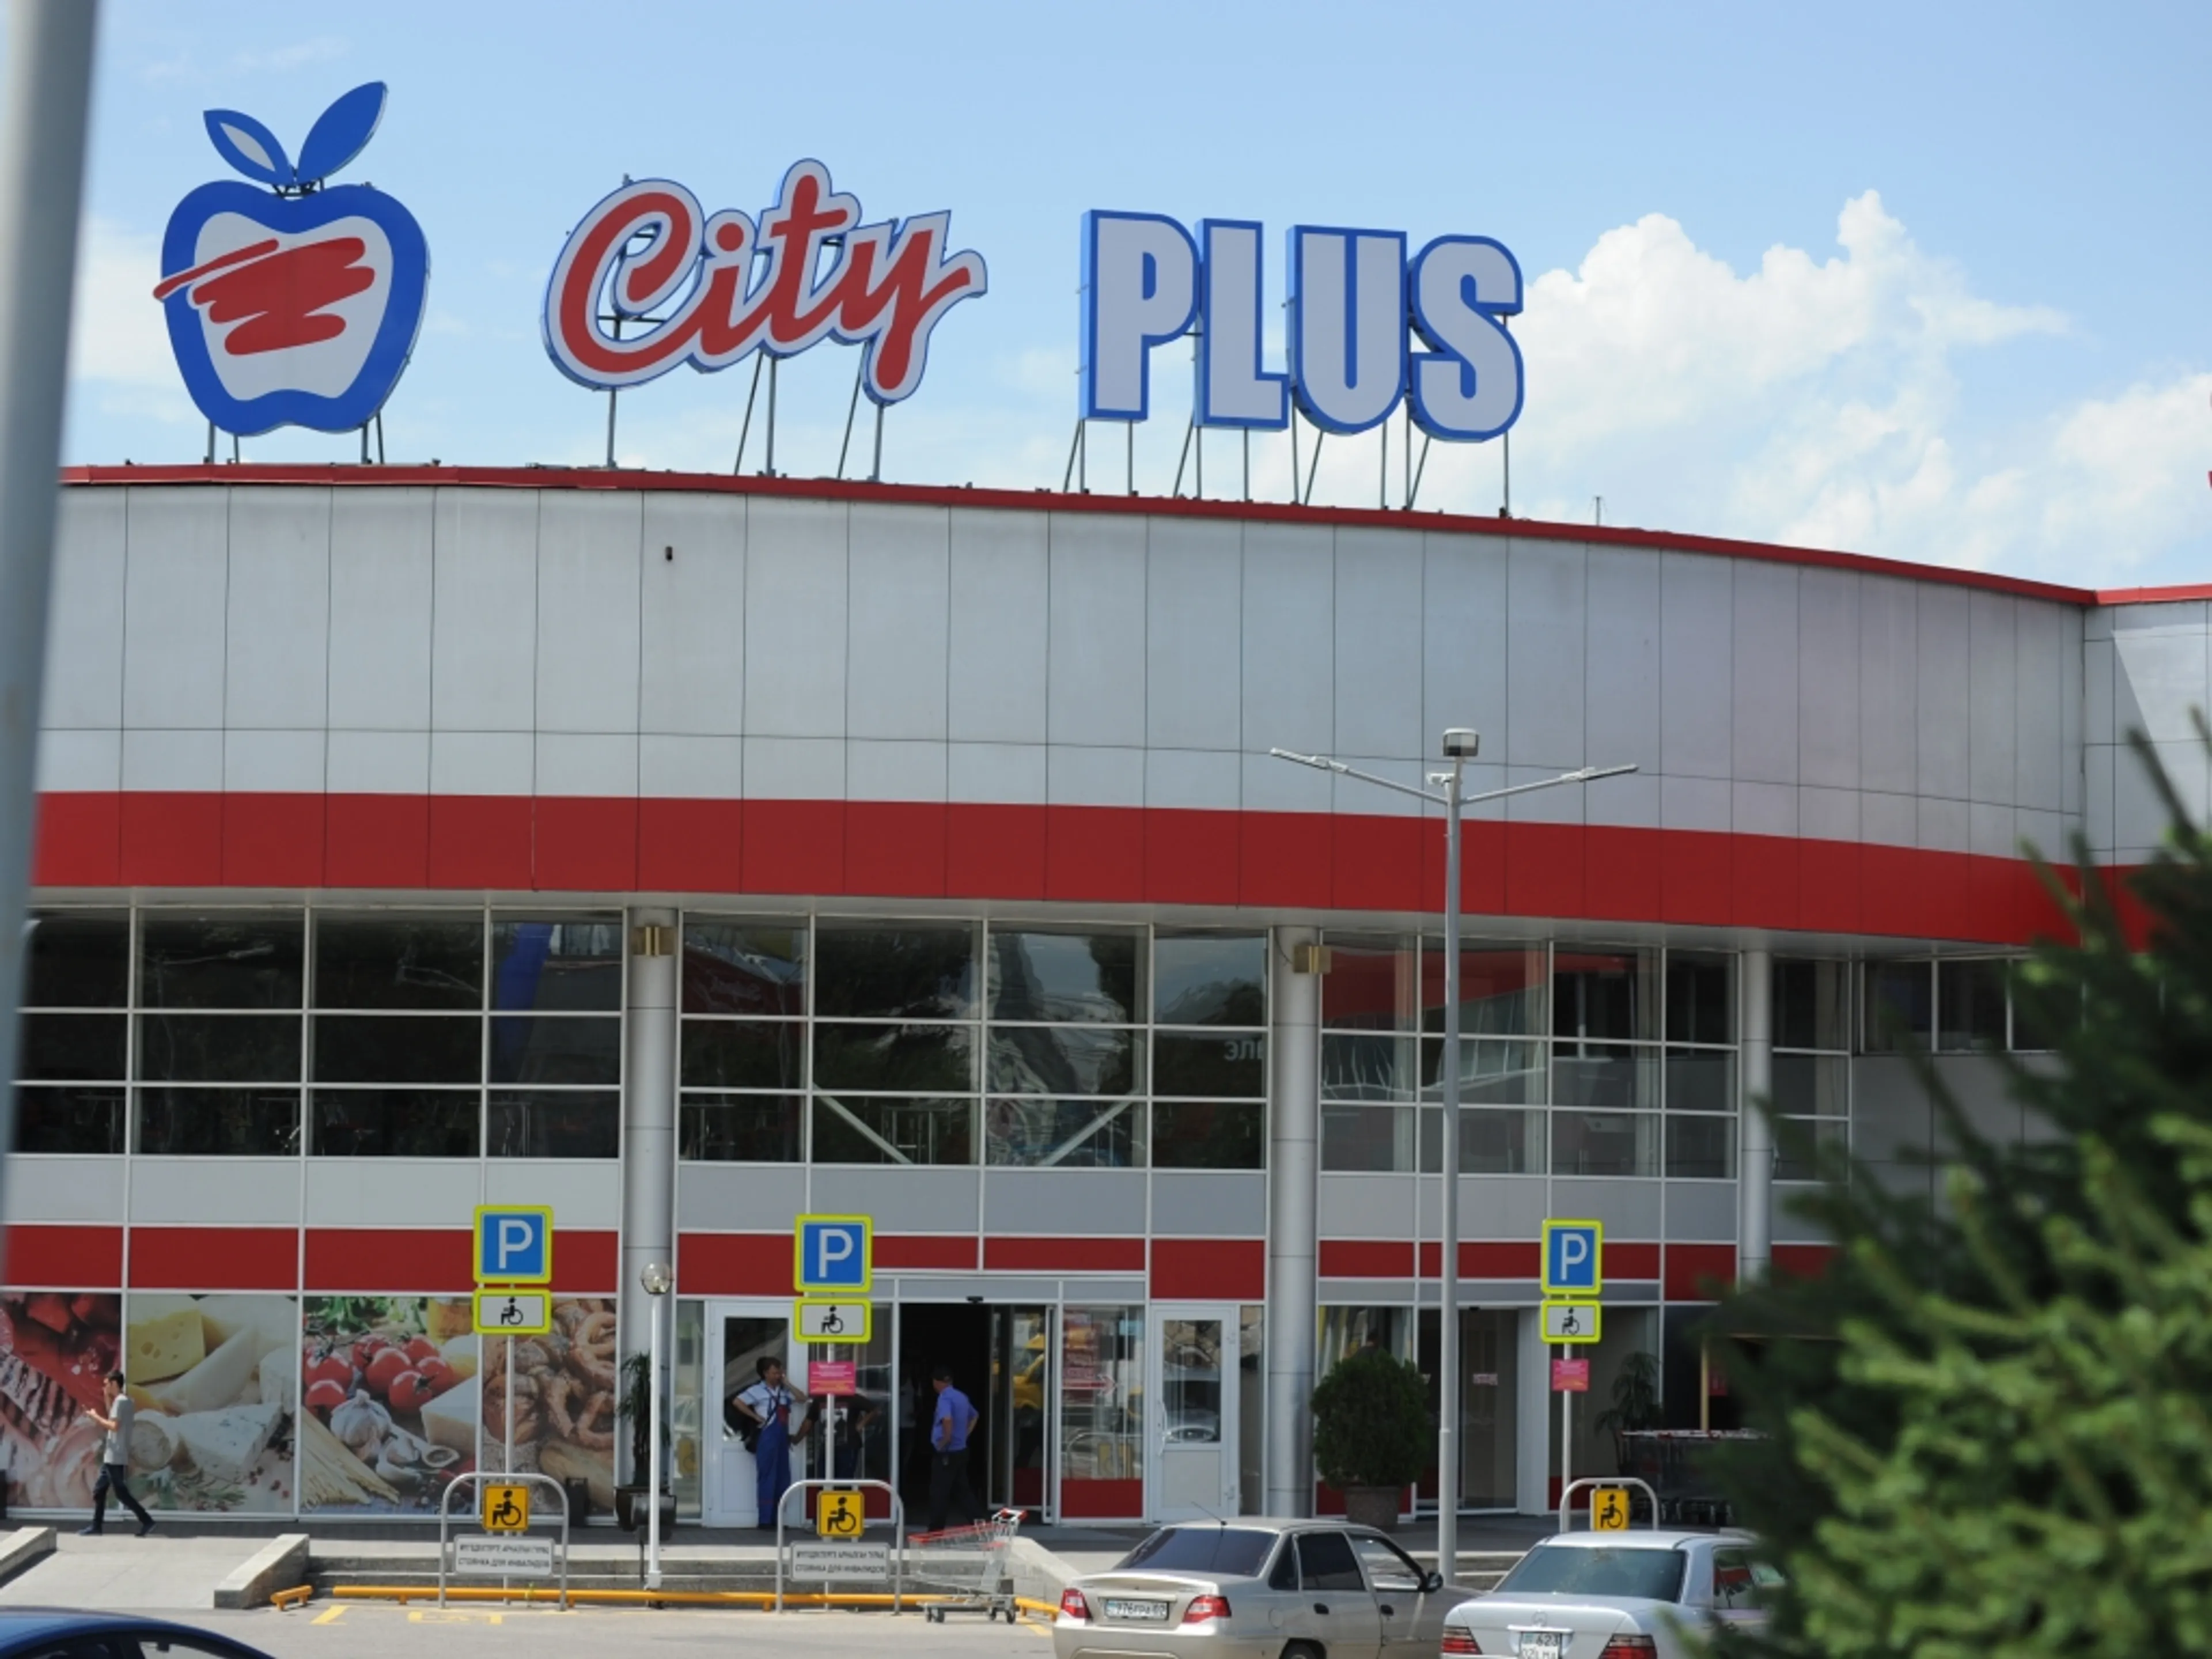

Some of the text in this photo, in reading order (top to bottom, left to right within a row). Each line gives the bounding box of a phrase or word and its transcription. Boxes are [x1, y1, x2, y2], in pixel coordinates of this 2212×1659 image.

[547, 159, 1523, 441] City PLUS
[498, 1219, 533, 1270] P
[818, 1228, 854, 1278] P
[1560, 1233, 1588, 1281] P
